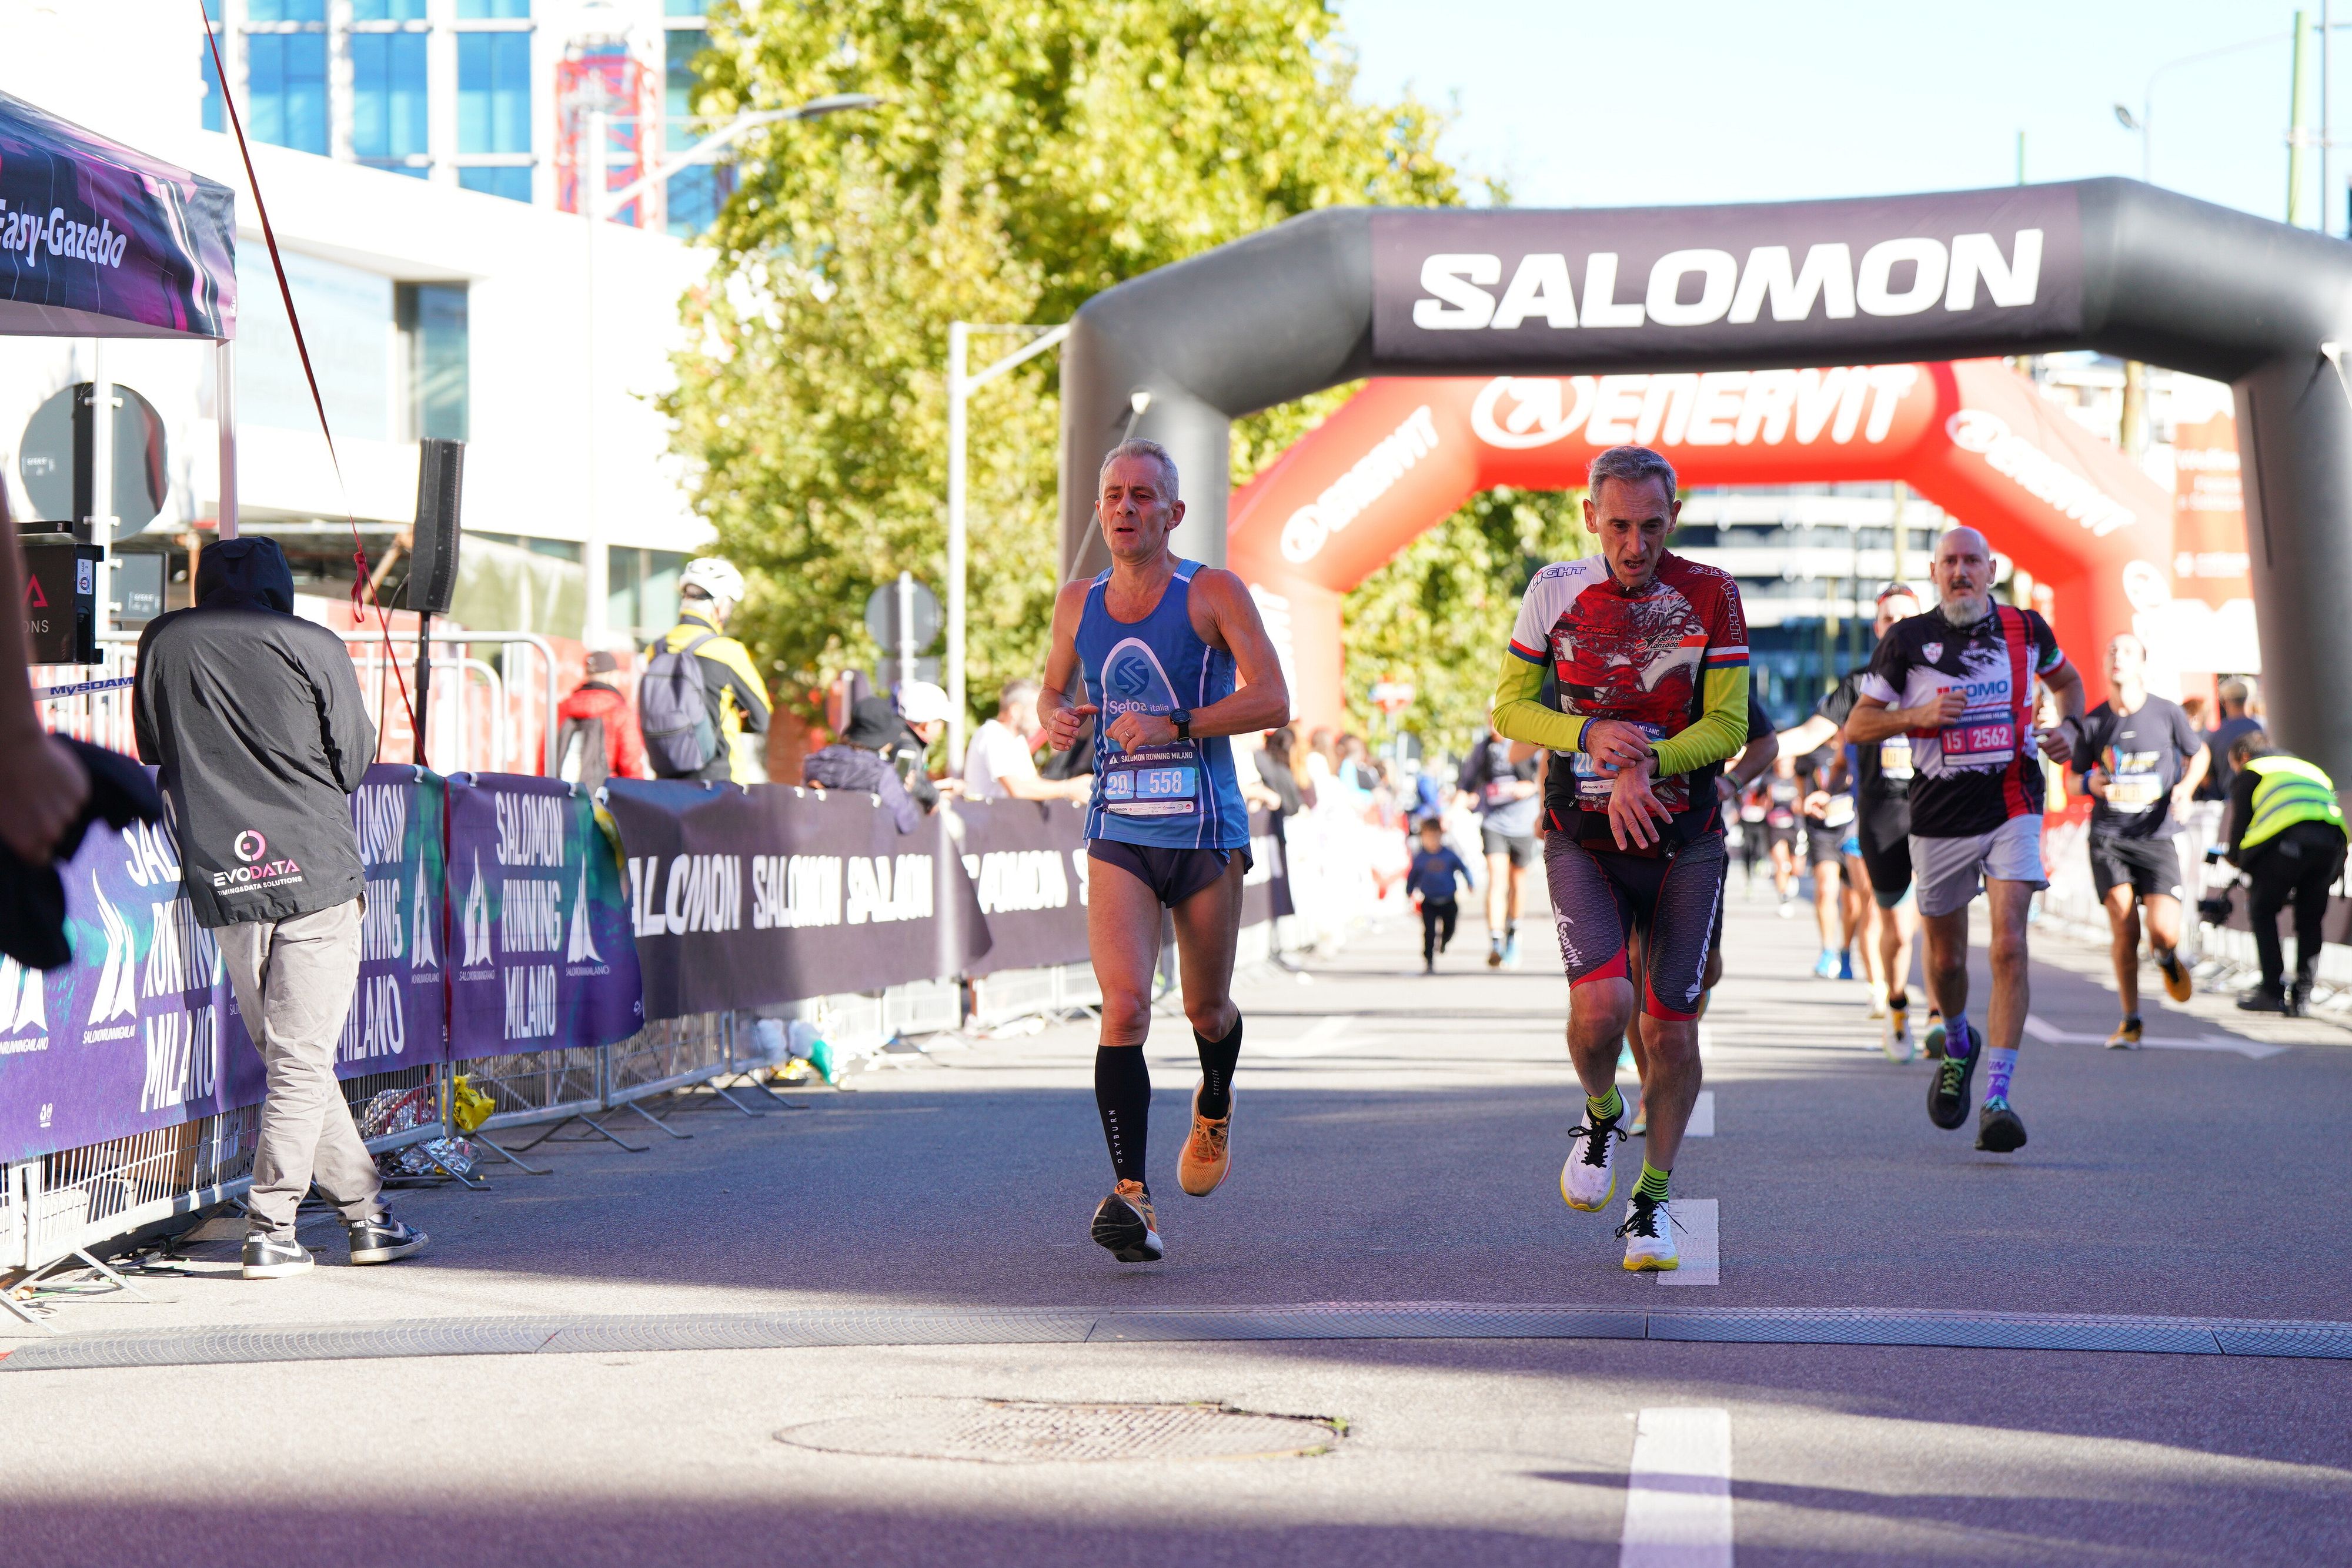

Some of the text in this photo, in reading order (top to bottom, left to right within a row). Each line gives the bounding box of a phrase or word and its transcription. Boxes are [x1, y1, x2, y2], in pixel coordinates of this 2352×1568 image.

[1413, 229, 2043, 329] SALOMON
[50, 676, 134, 696] MySDAM
[1944, 731, 1962, 750] 15
[1972, 726, 2009, 748] 2562
[1146, 753, 1170, 761] RUNNING
[1171, 751, 1193, 760] MILANO
[1150, 771, 1182, 794] 558
[347, 784, 406, 866] OMON
[495, 791, 564, 868] SALOMON
[213, 858, 300, 887] EVODATA
[262, 875, 303, 888] SOLUTIONS
[753, 855, 843, 930] SALOMON
[502, 879, 561, 953] RUNNING
[505, 964, 557, 1040] MILANO
[140, 1004, 216, 1113] MILANO
[1108, 1109, 1123, 1164] OXYBURN
[248, 1235, 265, 1243] NIKE
[352, 1220, 366, 1229] NIKE
